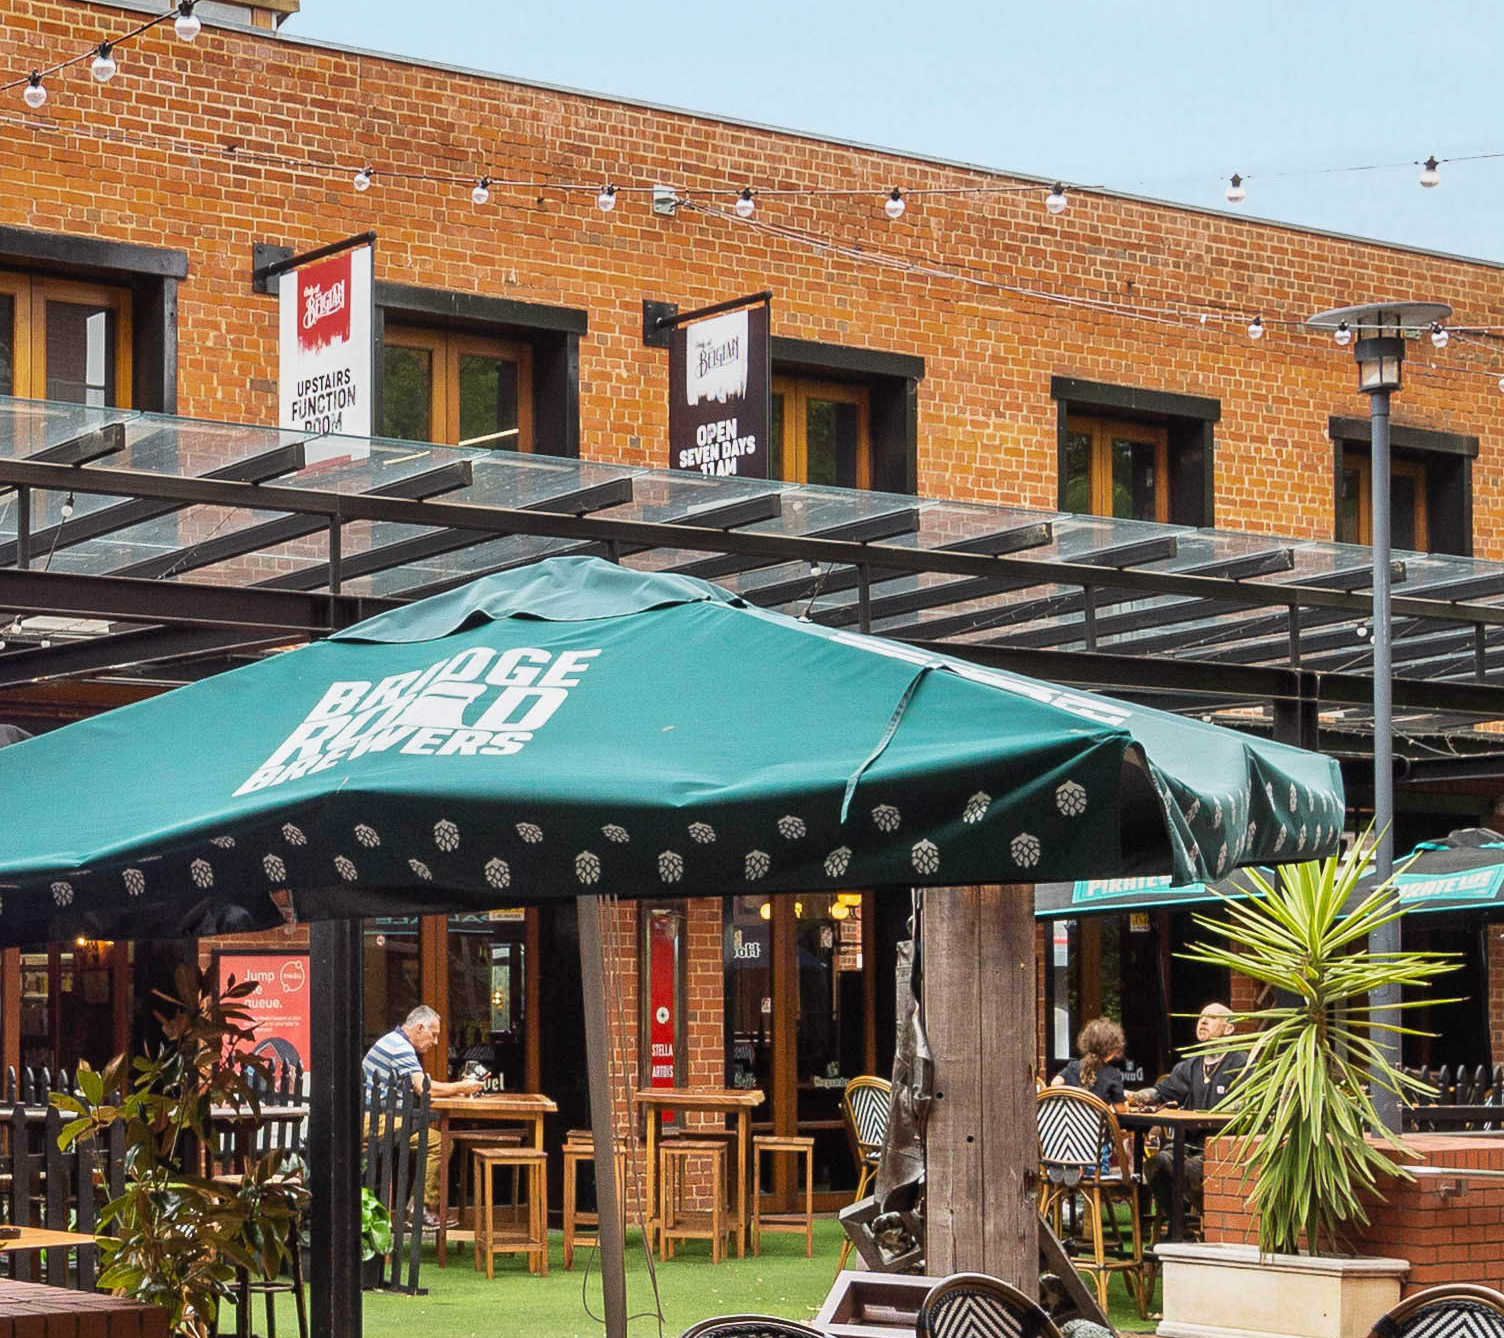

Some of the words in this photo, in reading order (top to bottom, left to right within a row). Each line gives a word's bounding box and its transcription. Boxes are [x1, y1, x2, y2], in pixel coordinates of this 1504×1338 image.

[303, 279, 345, 329] BELGIAN
[696, 336, 739, 379] BELGIAN
[298, 368, 351, 397] UPSTAIRS
[292, 385, 356, 421] FUNCTION
[696, 418, 738, 446] OPEN
[679, 443, 720, 468] SEVEN
[722, 435, 756, 459] DAYS
[304, 647, 602, 723] BRIDGE
[232, 726, 534, 798] BREWERS
[244, 969, 275, 983] Jump
[244, 998, 283, 1009] queue.
[652, 1044, 673, 1057] STELLA
[652, 1064, 673, 1078] ARTOIS
